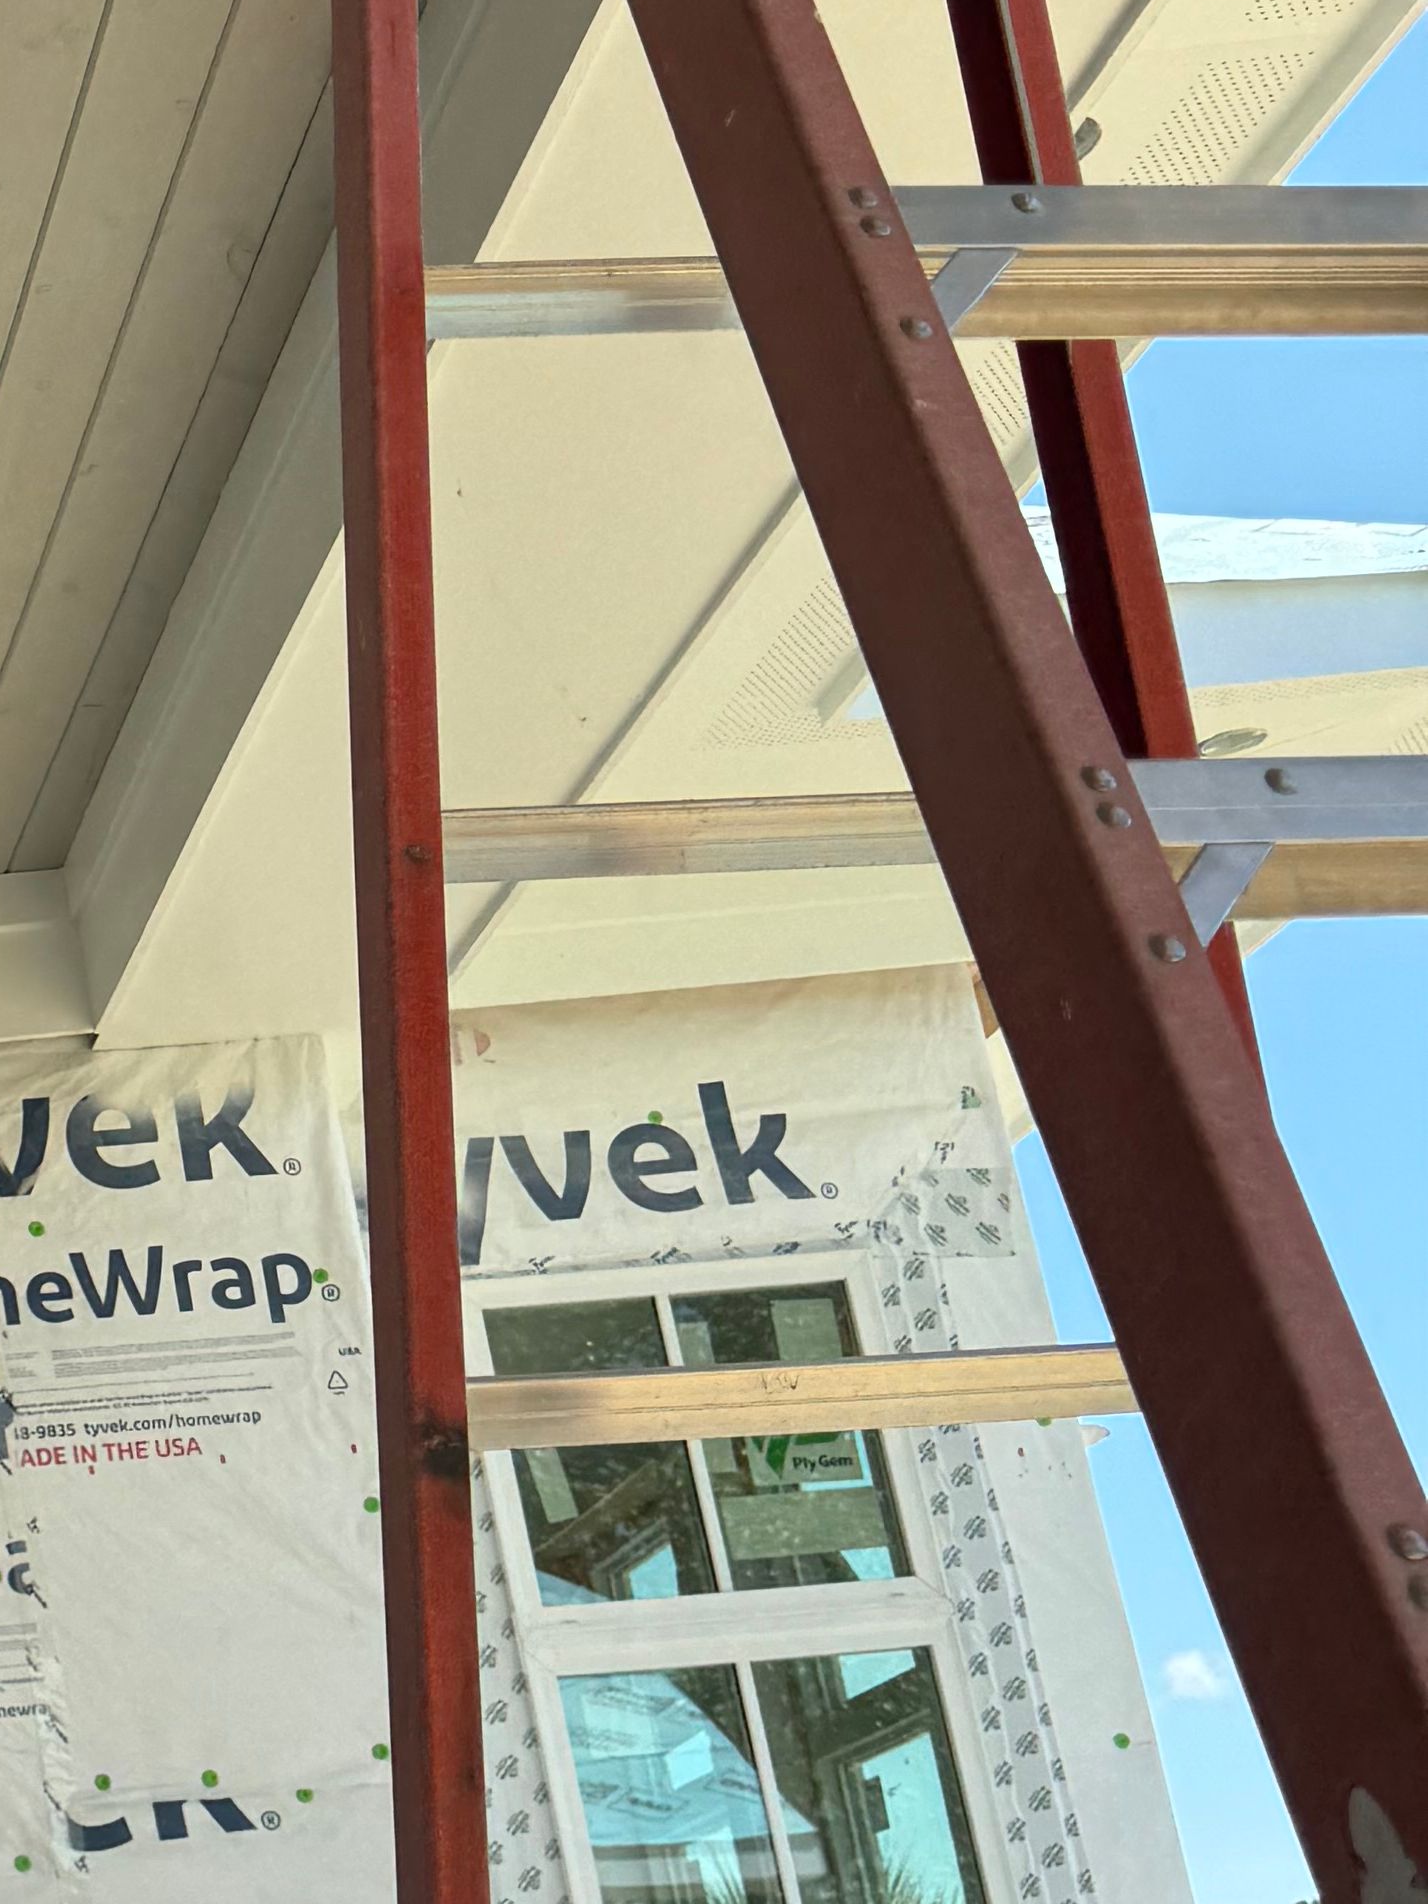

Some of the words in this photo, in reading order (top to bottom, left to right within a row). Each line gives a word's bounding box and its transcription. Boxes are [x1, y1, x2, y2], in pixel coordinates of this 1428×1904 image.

[84, 1410, 261, 1436] tyvek.com/homewrap
[21, 1447, 66, 1468] ADE
[73, 1444, 97, 1463] IN
[103, 1441, 148, 1461] THE
[155, 1437, 202, 1457] USA
[792, 1457, 815, 1472] Ply
[818, 1455, 853, 1467] Gem
